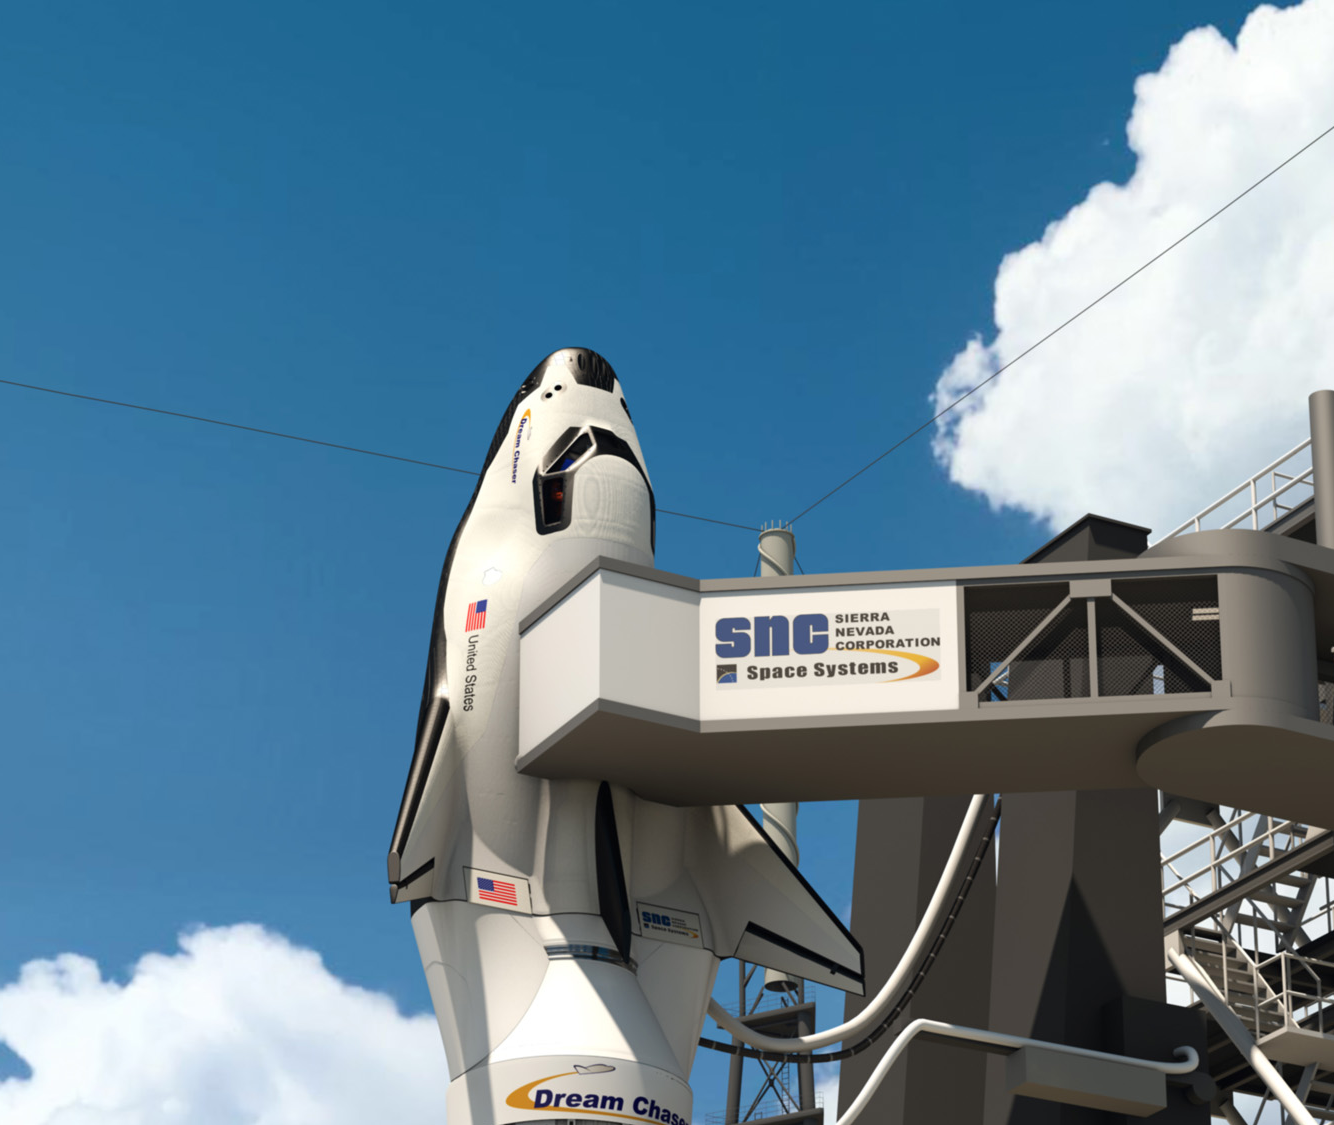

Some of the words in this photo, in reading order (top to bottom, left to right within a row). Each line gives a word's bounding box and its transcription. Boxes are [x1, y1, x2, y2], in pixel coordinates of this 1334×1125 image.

[515, 418, 528, 449] Dream
[511, 450, 521, 484] Chaser
[835, 612, 890, 624] SIERRA
[835, 625, 895, 637] NEVADA
[466, 634, 479, 672] United
[835, 637, 941, 651] CORPORATION
[746, 664, 808, 681] Space
[813, 661, 899, 678] Systems
[463, 674, 477, 712] States
[534, 1089, 625, 1111] Dream
